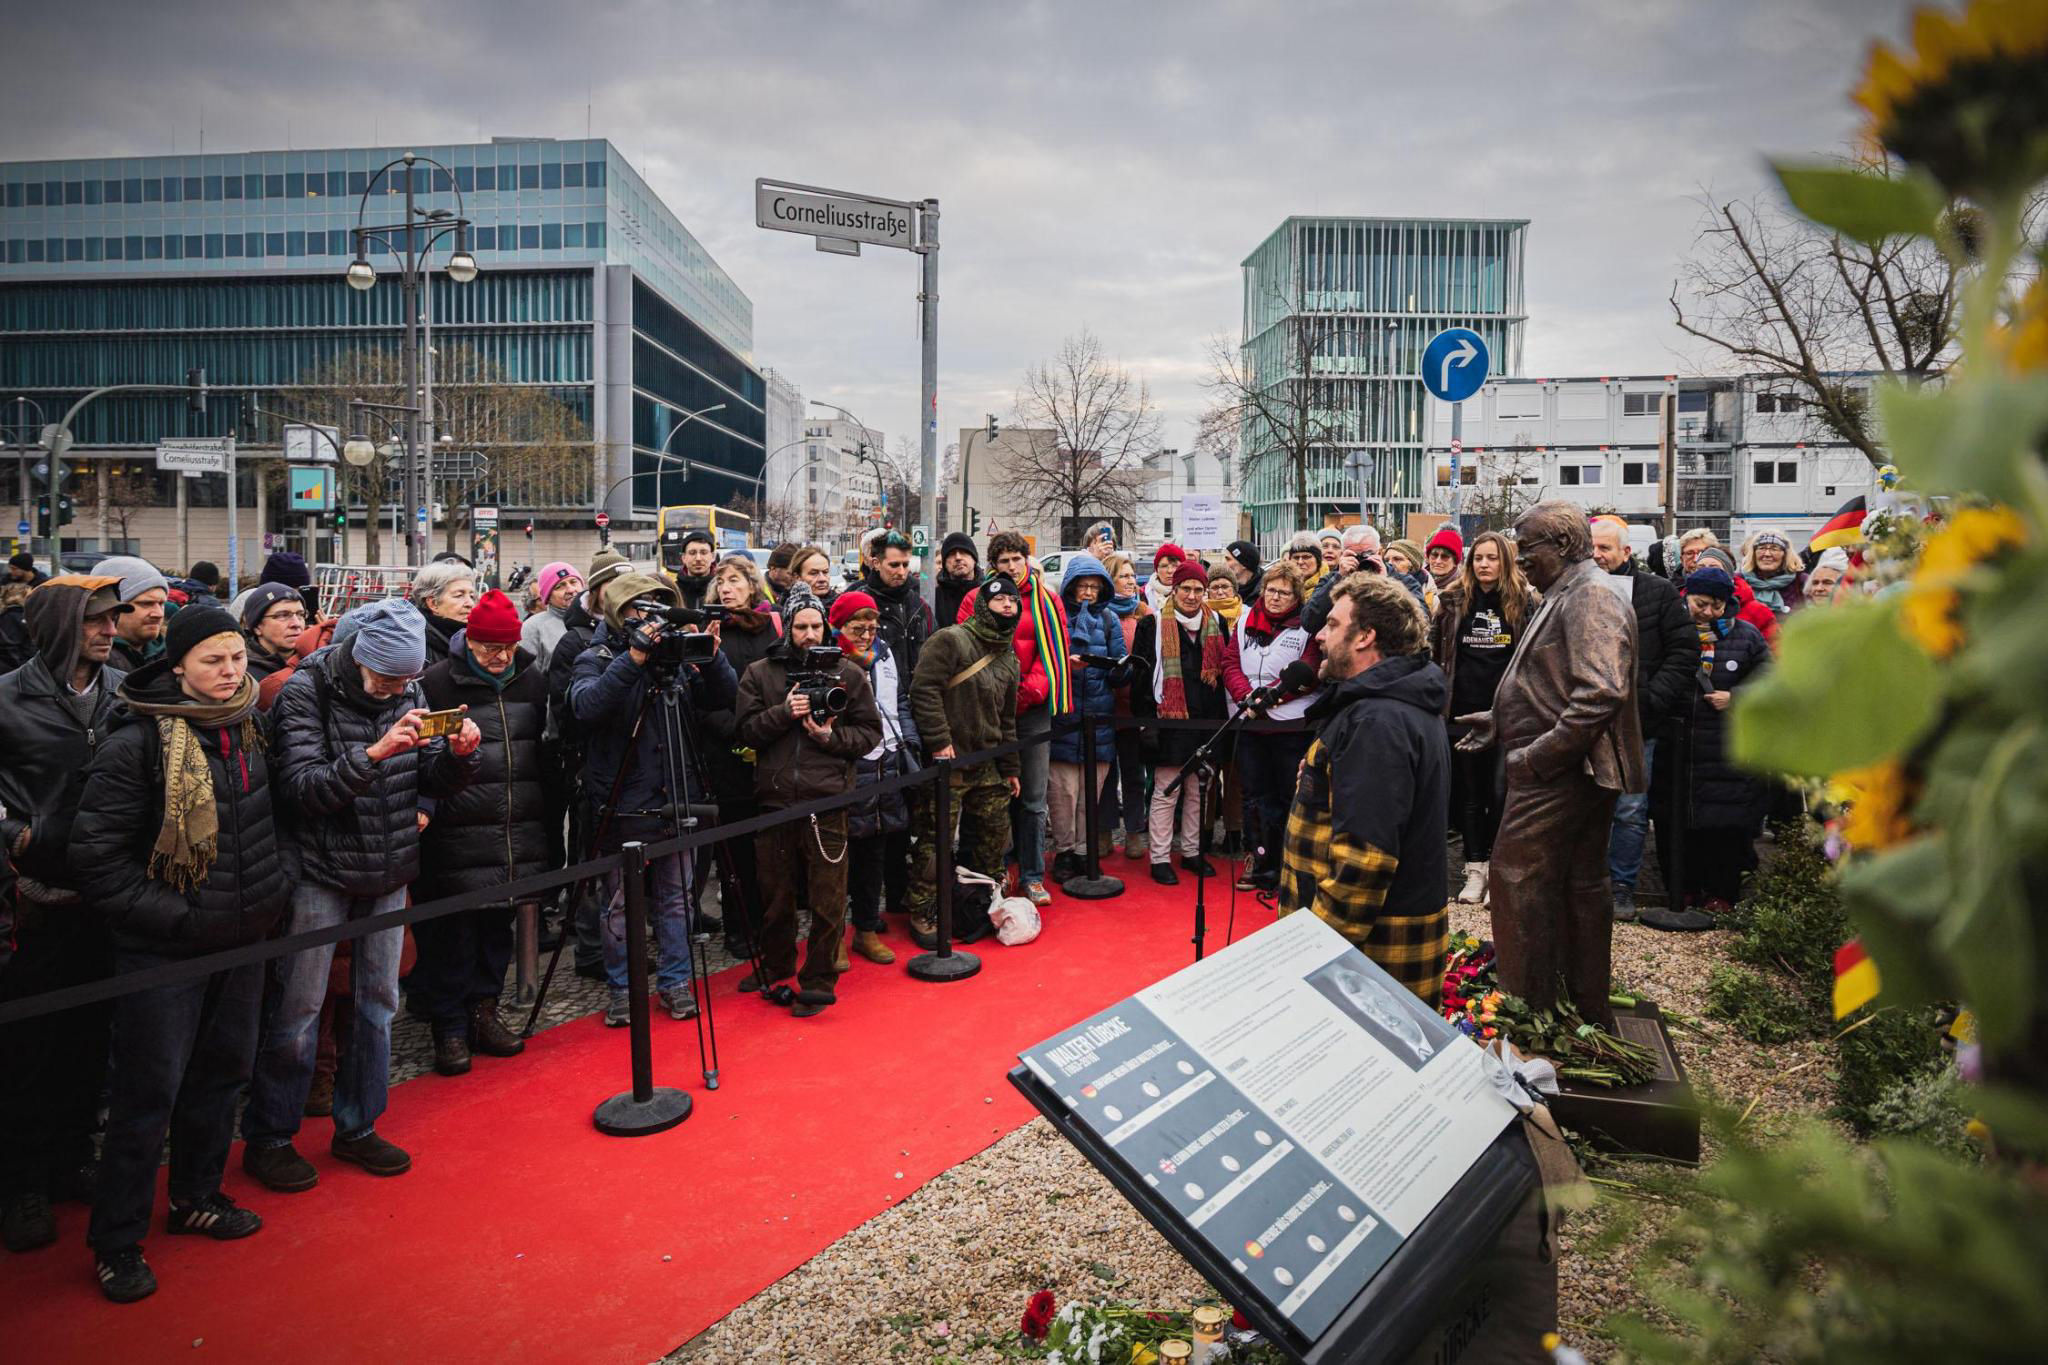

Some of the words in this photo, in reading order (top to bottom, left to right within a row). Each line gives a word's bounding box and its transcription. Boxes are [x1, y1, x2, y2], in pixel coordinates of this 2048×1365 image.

[773, 197, 907, 237] Corneliusstraße
[163, 452, 220, 467] Corneliusstraße
[1462, 636, 1494, 644] ADENAUER
[1044, 1033, 1097, 1067] WALTER
[1086, 1015, 1132, 1047] LÜBCKE
